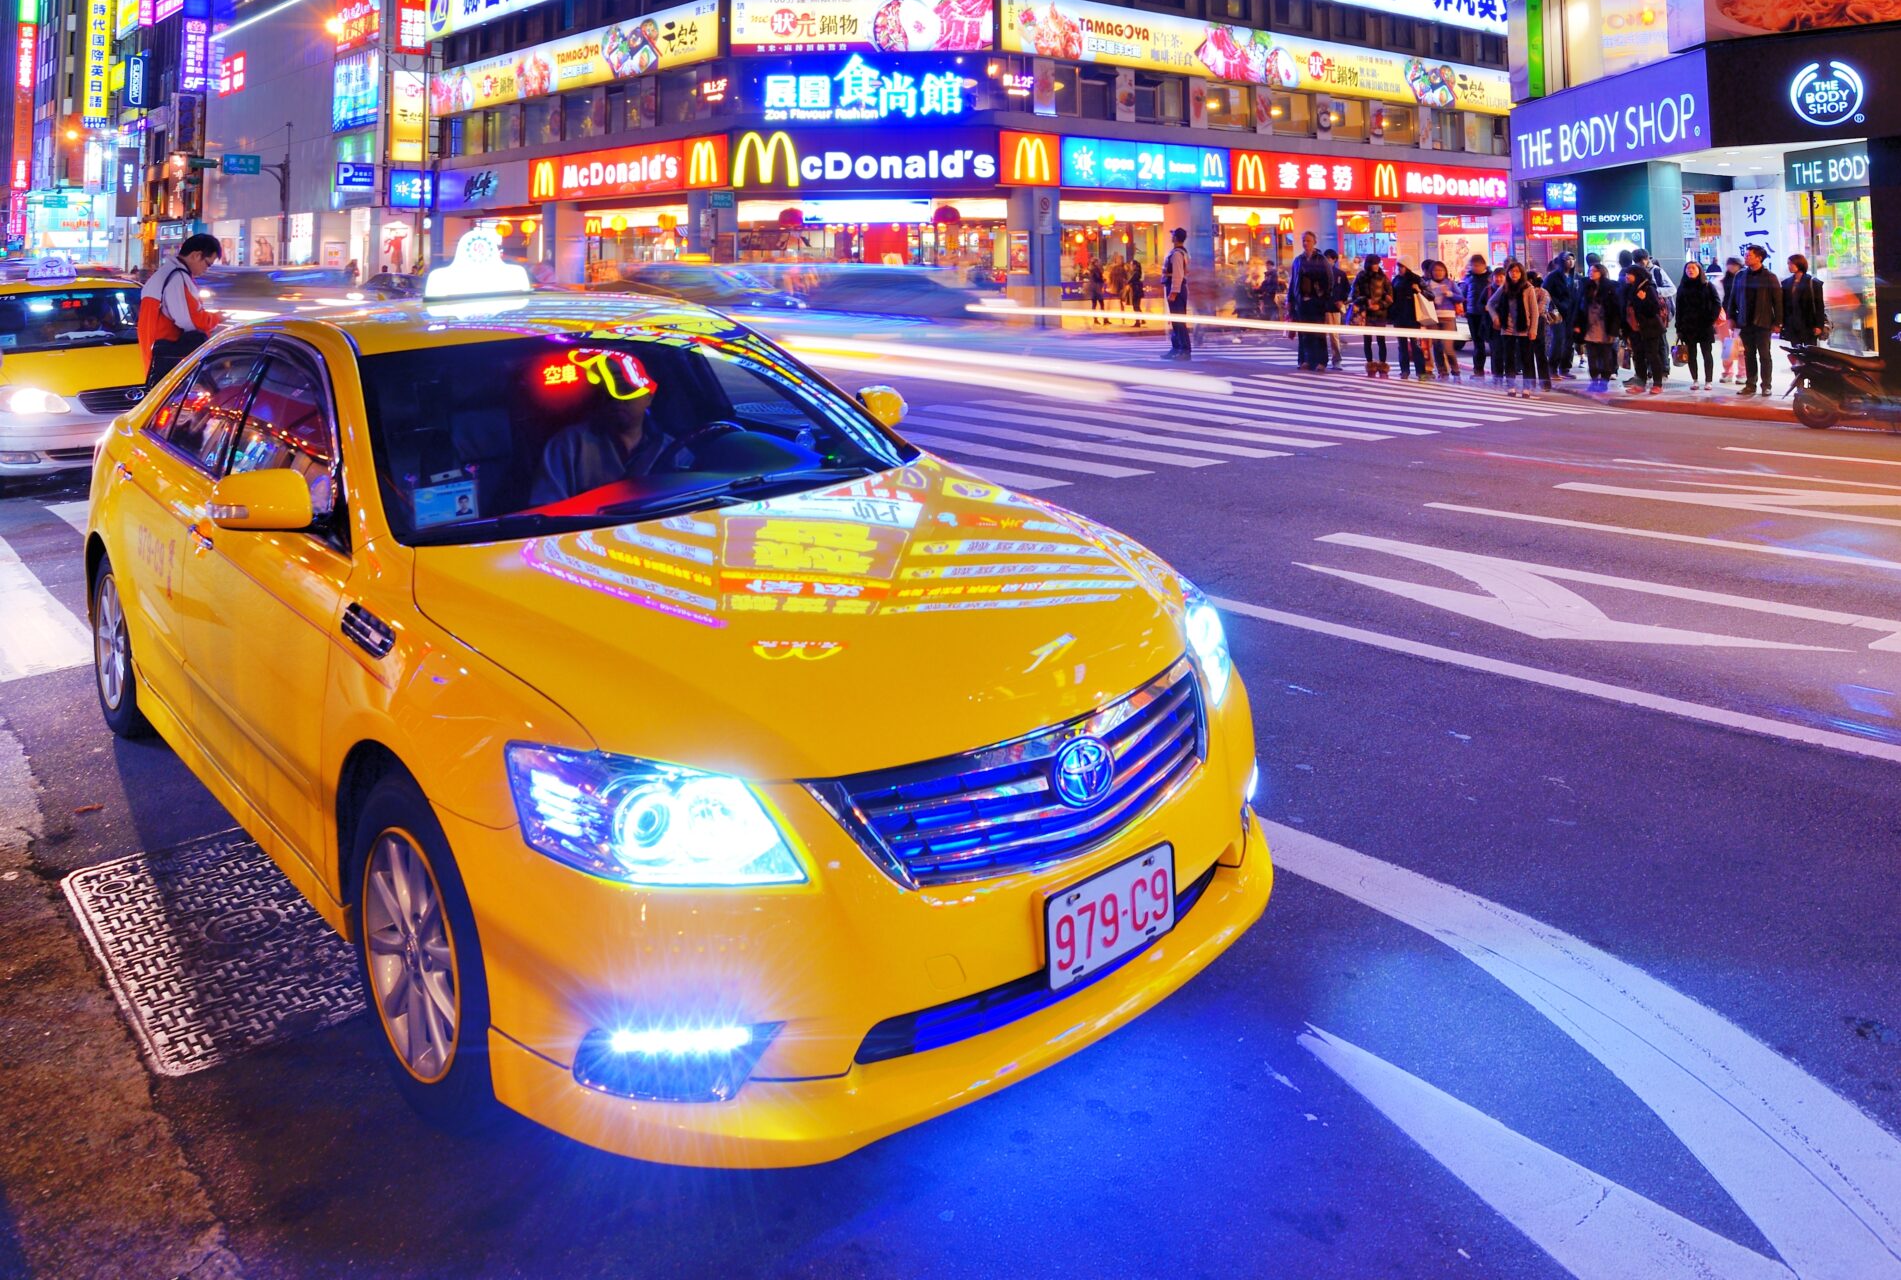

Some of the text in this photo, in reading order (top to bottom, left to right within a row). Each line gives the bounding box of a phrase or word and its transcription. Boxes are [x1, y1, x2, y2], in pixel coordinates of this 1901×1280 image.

[1079, 17, 1149, 41] TAMAGOYA
[90, 4, 106, 108] 時代國際英日語
[556, 44, 600, 64] TAMAGOYA
[1805, 90, 1849, 104] BODY
[1813, 80, 1839, 91] THE
[1809, 101, 1848, 114] SHOP
[1518, 93, 1695, 169] THE BODY SHOP
[124, 164, 133, 192] NET
[338, 164, 355, 185] P
[562, 153, 678, 189] McDonald's
[1138, 152, 1165, 180] 24
[1278, 162, 1353, 192] 麥當勞
[1792, 160, 1824, 185] THE
[1406, 171, 1507, 200] McDonald's
[1582, 215, 1597, 223] THE
[1599, 215, 1620, 223] BODY
[543, 365, 579, 387] 空車
[1055, 868, 1169, 971] 979-C9
